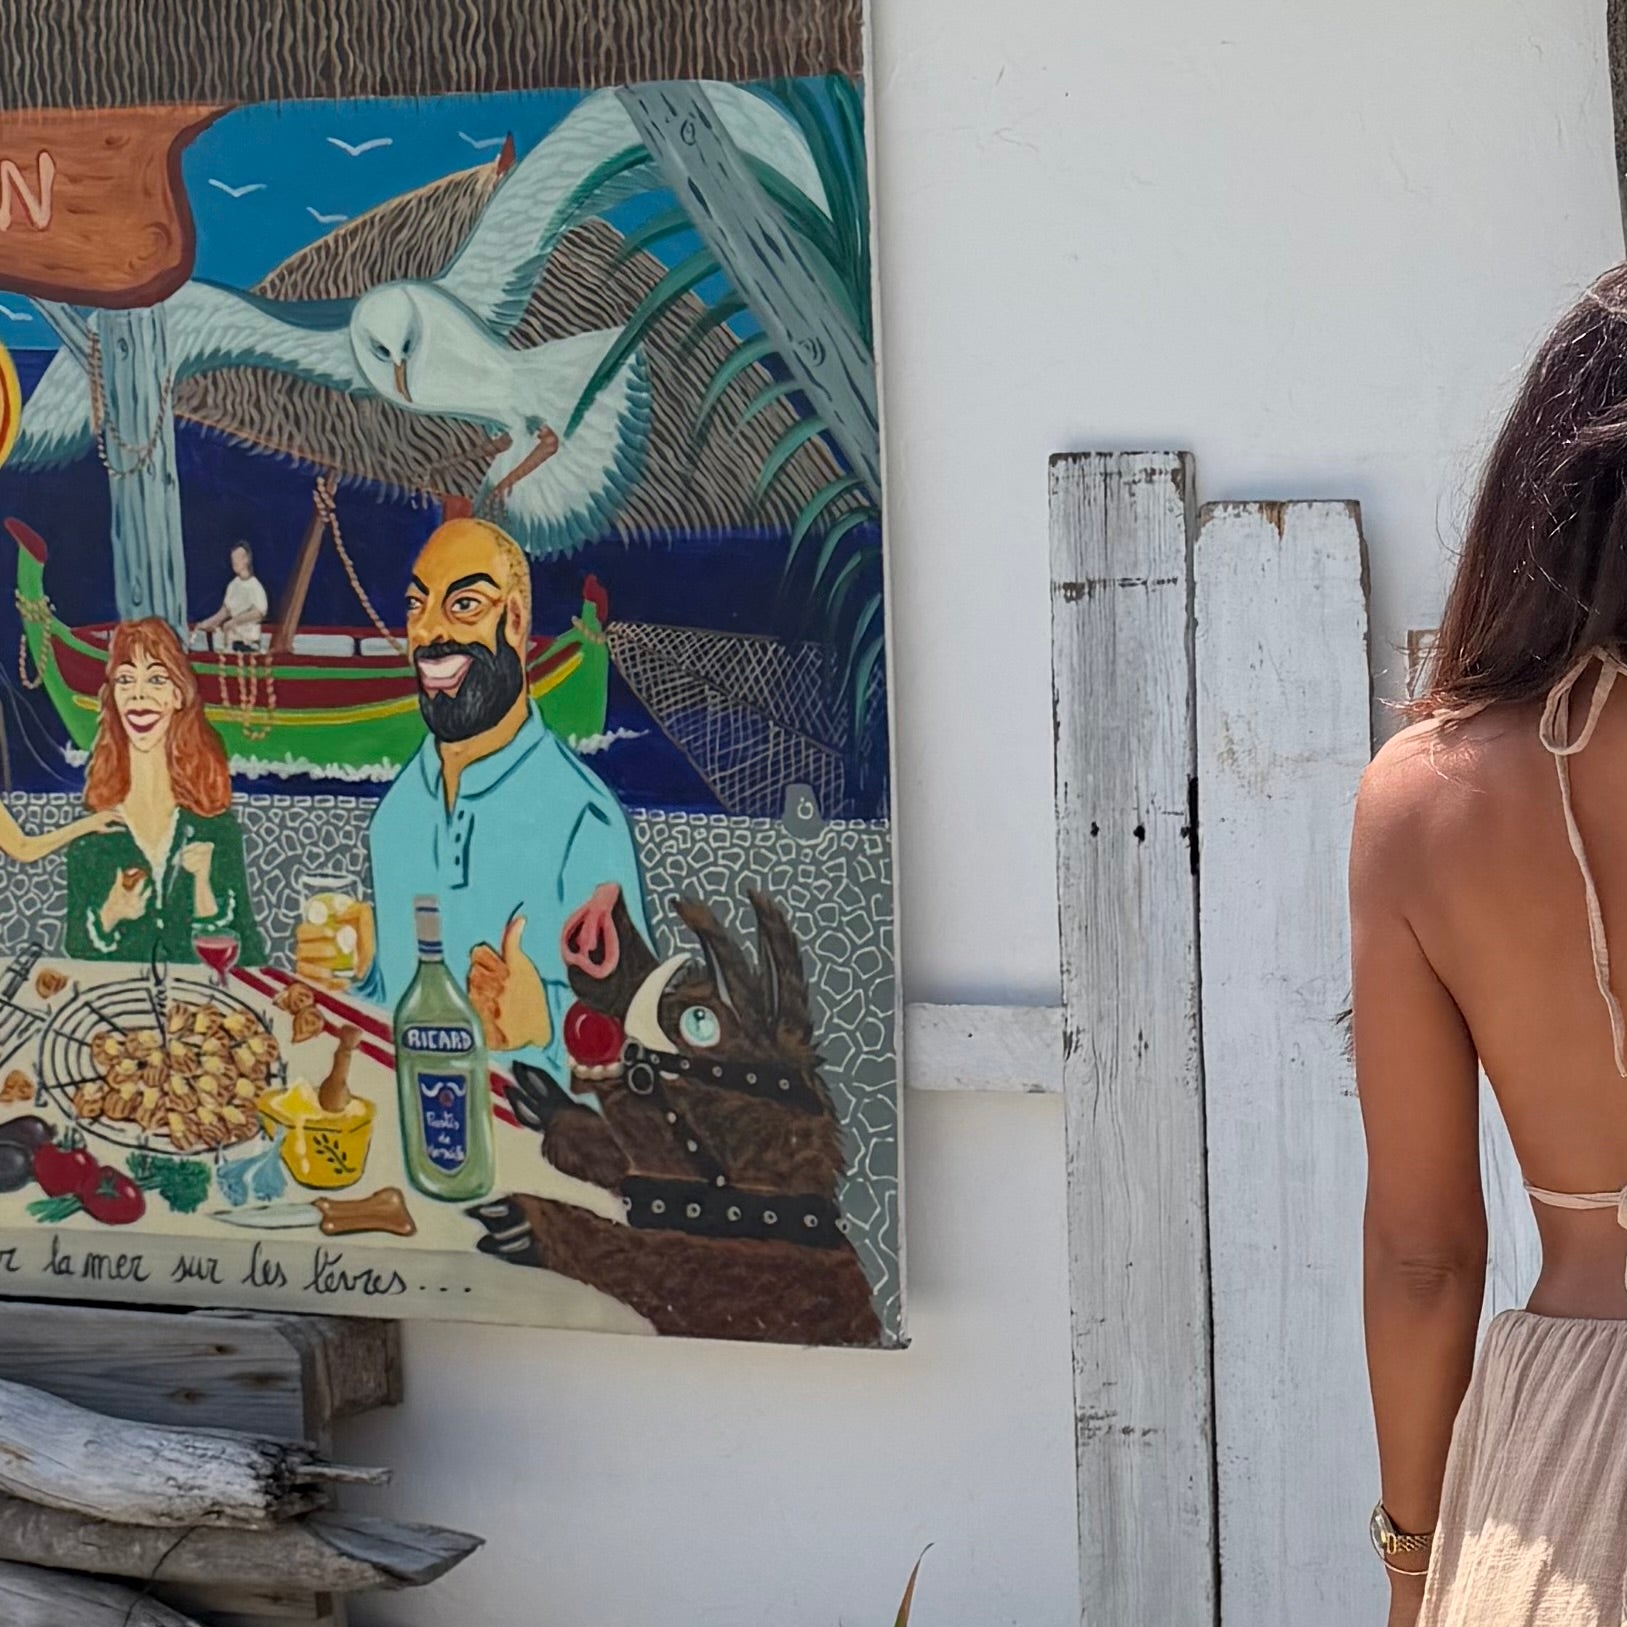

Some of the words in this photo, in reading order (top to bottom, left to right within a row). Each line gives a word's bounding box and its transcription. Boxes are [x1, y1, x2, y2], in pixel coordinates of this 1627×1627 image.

[407, 1029, 472, 1050] RICARD
[81, 1252, 151, 1282] mer
[171, 1254, 223, 1284] sur
[241, 1241, 288, 1288] les
